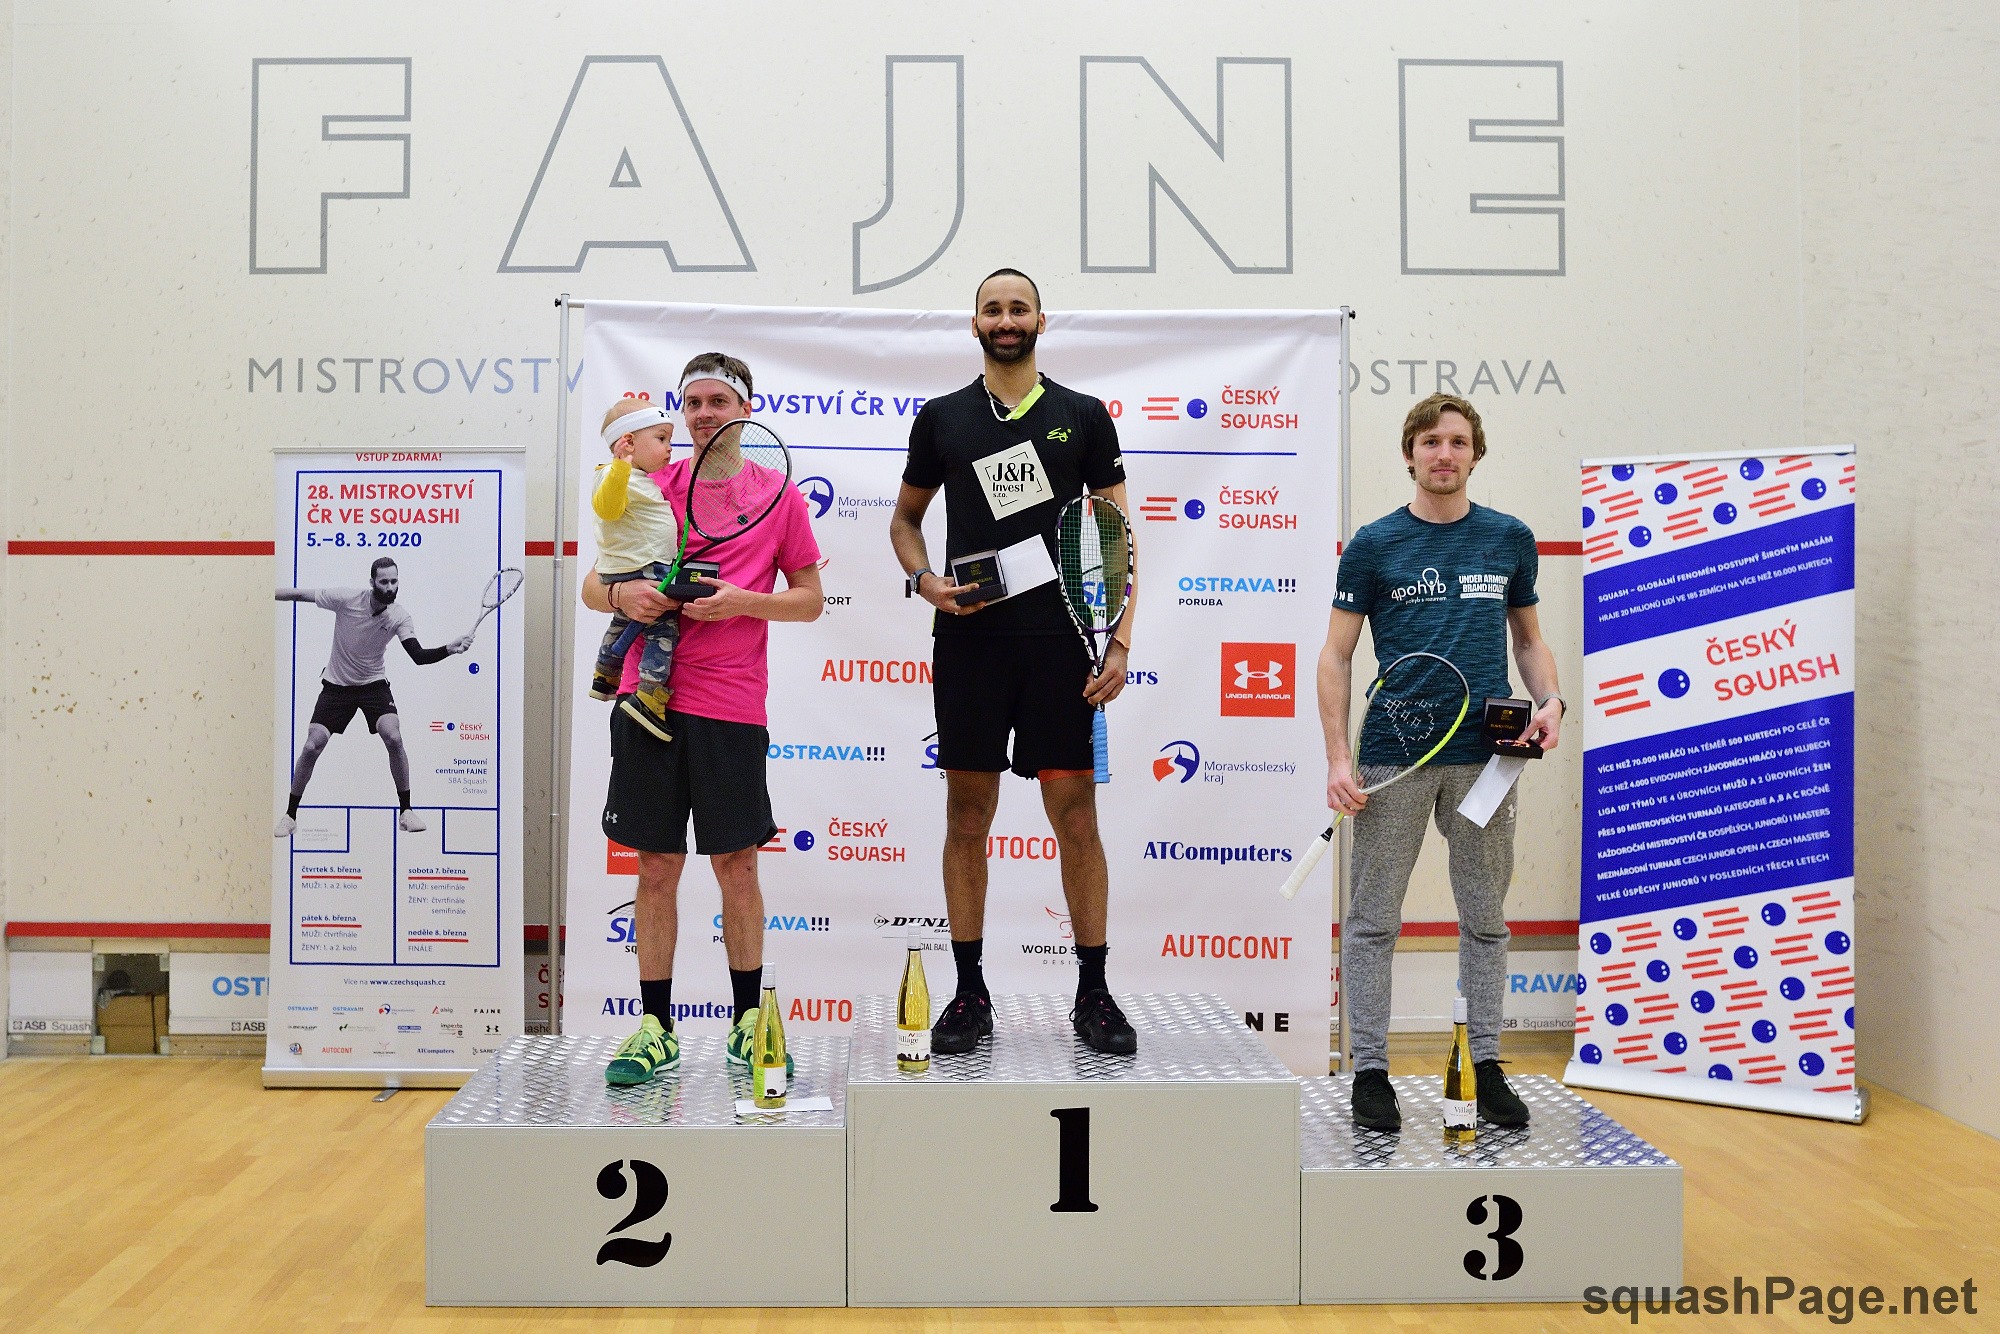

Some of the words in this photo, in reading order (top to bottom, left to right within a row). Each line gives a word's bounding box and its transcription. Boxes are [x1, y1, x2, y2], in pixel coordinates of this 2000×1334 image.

[248, 54, 1566, 295] FAJNE
[1221, 385, 1280, 405] ČESKÝ
[850, 390, 884, 416] ČR
[893, 397, 926, 417] VE
[1221, 413, 1298, 429] SQUASH
[356, 452, 389, 462] VSTUP
[392, 452, 442, 462] ZDARMA!
[992, 462, 1035, 482] J&R
[307, 485, 334, 500] 28.
[340, 479, 475, 500] MISTROVSTVÍ
[992, 482, 1024, 492] Invest
[1219, 486, 1279, 505] ČESKÝ
[307, 504, 333, 524] ČR
[339, 508, 364, 524] VE
[370, 508, 460, 525] SQUASHI
[838, 508, 858, 520] kraj
[1219, 514, 1297, 530] SQUASH
[307, 532, 351, 547] 5.–8.
[356, 532, 372, 547] 3.
[377, 532, 422, 547] 2020
[1598, 588, 1629, 603] SQUASH
[1636, 574, 1676, 593] GLOBÁLNÍ
[1676, 565, 1717, 583] FENOMÉN
[1717, 552, 1760, 572] DOSTUPNÝ
[1761, 543, 1800, 561] ŠIROKÝM
[1800, 535, 1834, 550] MASÁM
[1178, 577, 1296, 593] OSTRAVA!!!
[1458, 575, 1483, 584] UNDER
[1462, 584, 1487, 593] BRAND
[1178, 598, 1223, 606] PORUBA
[1706, 618, 1797, 667] ČESKÝ
[1714, 653, 1840, 701] SQUASH
[459, 722, 483, 731] ČESKÝ
[767, 744, 885, 762] OSTRAVA!!!
[1597, 763, 1615, 774] VÍCE
[1615, 758, 1632, 771] NEŽ
[1631, 754, 1658, 767] 70.000
[1657, 747, 1686, 761] HRÁČŮ
[1686, 745, 1700, 755] NA
[1700, 738, 1728, 752] TÉMĚŘ
[1727, 736, 1743, 747] 500
[1743, 727, 1782, 743] KURTECH
[1781, 724, 1795, 734] PO
[1796, 718, 1818, 731] CELÉ
[1818, 716, 1831, 727] ČR
[453, 758, 488, 766] Sportovní
[1204, 761, 1297, 775] Moravskoslezský
[1597, 785, 1615, 795] VÍCE
[1614, 780, 1630, 792] NEŽ
[1702, 756, 1749, 774] ZÁVODNÍCH
[1748, 749, 1777, 764] HRÁČŮ
[1793, 739, 1831, 754] KLUBECH
[1204, 772, 1224, 785] kraj
[1597, 806, 1617, 817] LIGA
[1617, 803, 1630, 813] 107
[1631, 796, 1656, 810] TÝMŮ
[1656, 795, 1669, 804] VE
[1676, 784, 1721, 801] ÚROVNÍCH
[1722, 777, 1748, 791] MUŽŮ
[1764, 765, 1812, 783] ÚROVNÍCH
[1812, 761, 1832, 773] ŽEN
[828, 817, 889, 838] ČESKÝ
[1597, 841, 1646, 860] KAŽDOROČNÍ
[1645, 831, 1696, 850] MISTROVSTVÍ
[1696, 830, 1708, 840] ČR
[1754, 814, 1789, 829] JUNIORŮ
[1792, 807, 1831, 822] MASTERS
[828, 845, 905, 863] SQUASH
[1143, 841, 1293, 865] ATComputers
[442, 867, 466, 875] března
[1596, 889, 1622, 902] VELKÉ
[1622, 883, 1661, 898] ÚSPĚCHY
[1662, 875, 1700, 891] JUNIORŮ
[1709, 865, 1765, 882] POSLEDNÍCH
[1765, 859, 1795, 872] TŘECH
[1795, 853, 1830, 866] LETECH
[430, 883, 466, 891] semifinále
[408, 896, 429, 904] ŽENY:
[431, 896, 466, 904] čtvrtfinále
[301, 914, 323, 922] pátek
[431, 907, 466, 915] semifinále
[443, 929, 467, 937] března
[1021, 944, 1066, 954] WORLD
[1161, 934, 1293, 960] AUTOCONT
[212, 976, 269, 997] OST
[369, 979, 446, 987] www.czechsquash.cz
[24, 1021, 47, 1031] ASB
[51, 1021, 91, 1032] Squash
[242, 1021, 266, 1031] ASB
[1502, 1020, 1518, 1029] SB
[1050, 1108, 1098, 1212] 1
[597, 1159, 671, 1267] 2
[1464, 1195, 1523, 1280] 3
